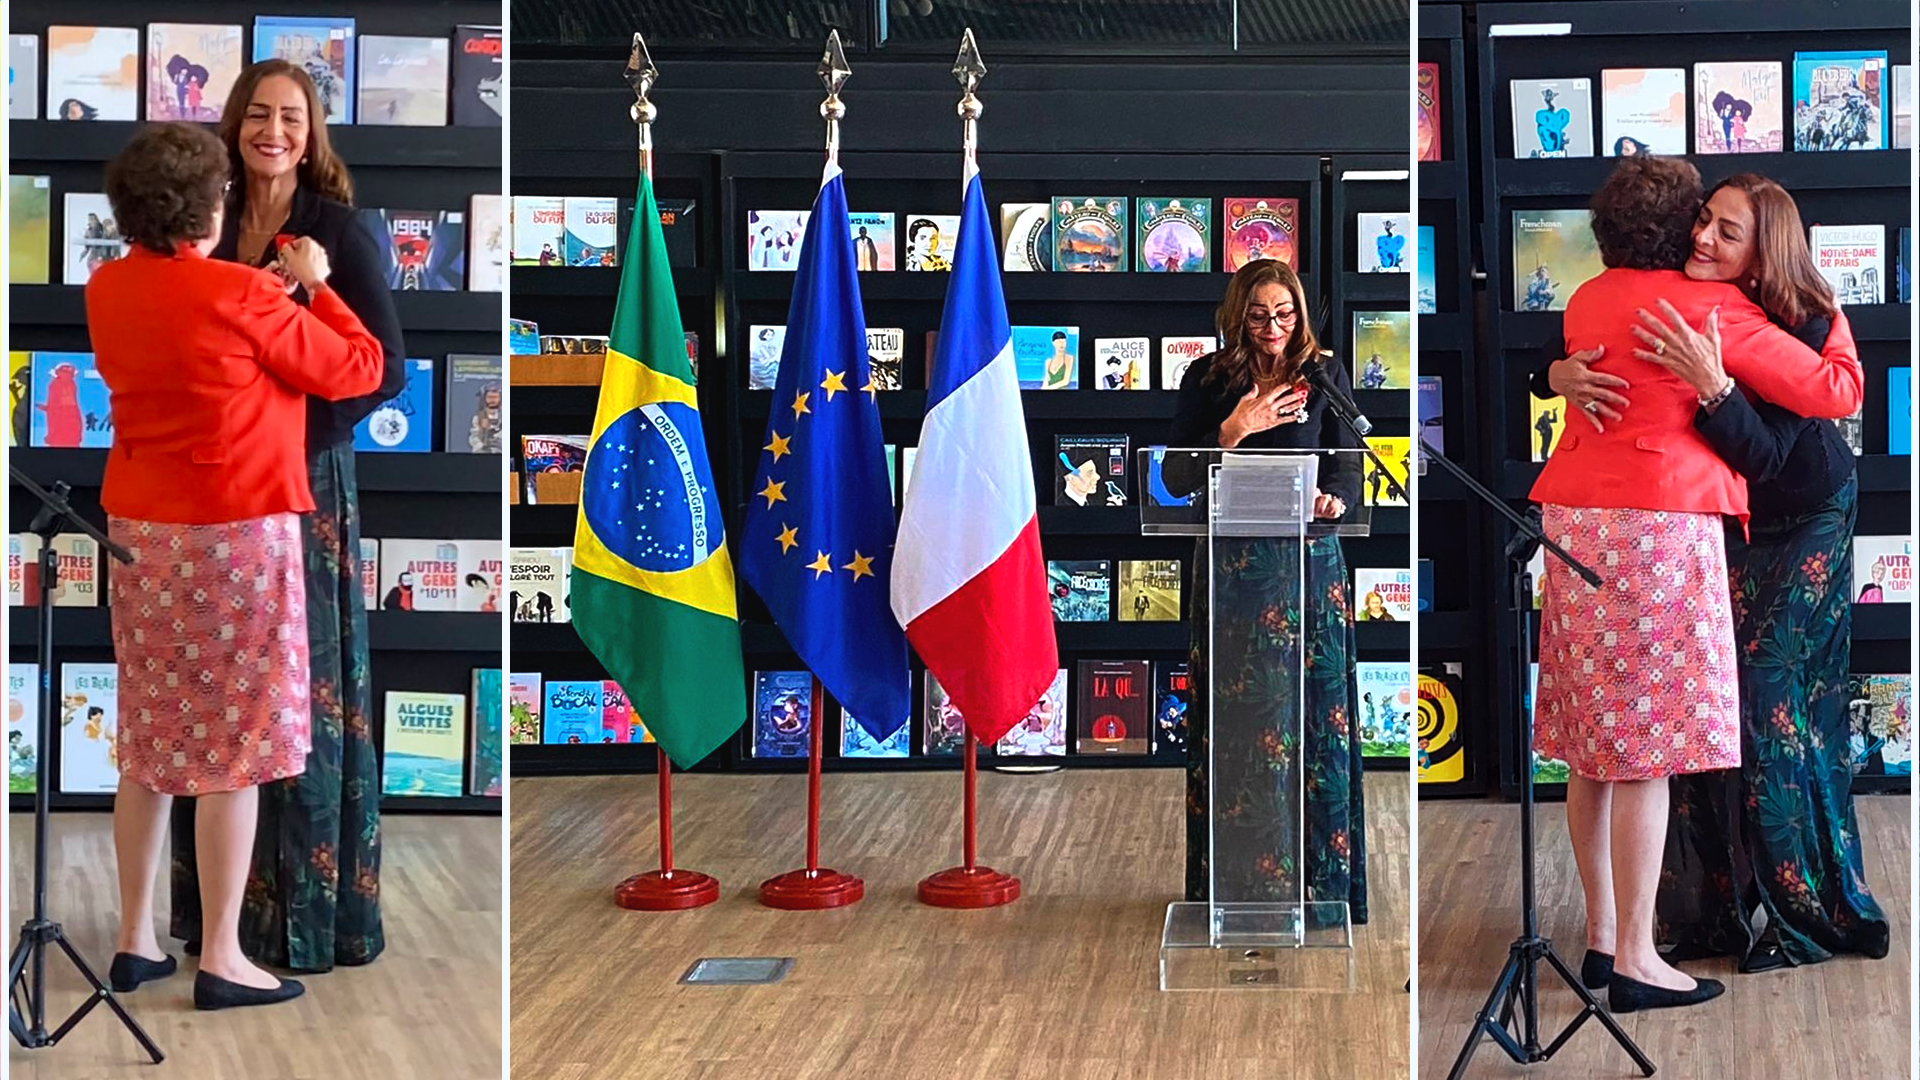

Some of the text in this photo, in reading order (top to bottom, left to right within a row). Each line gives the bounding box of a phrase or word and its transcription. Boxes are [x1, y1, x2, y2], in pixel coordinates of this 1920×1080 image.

[393, 219, 433, 236] 1984
[1820, 248, 1877, 258] NOTRE-DAME
[1820, 258, 1860, 268] DE PARIS
[1112, 342, 1145, 350] ALICE
[1168, 343, 1205, 355] OLYMPE
[1121, 350, 1145, 359] GUY
[654, 415, 686, 456] ORDEM
[685, 471, 705, 547] PROGRESSO
[407, 561, 458, 572] AUTRES
[60, 569, 93, 581] GENS
[422, 574, 457, 586] GENS
[397, 703, 453, 717] ALGUES
[398, 715, 451, 728] VERTES
